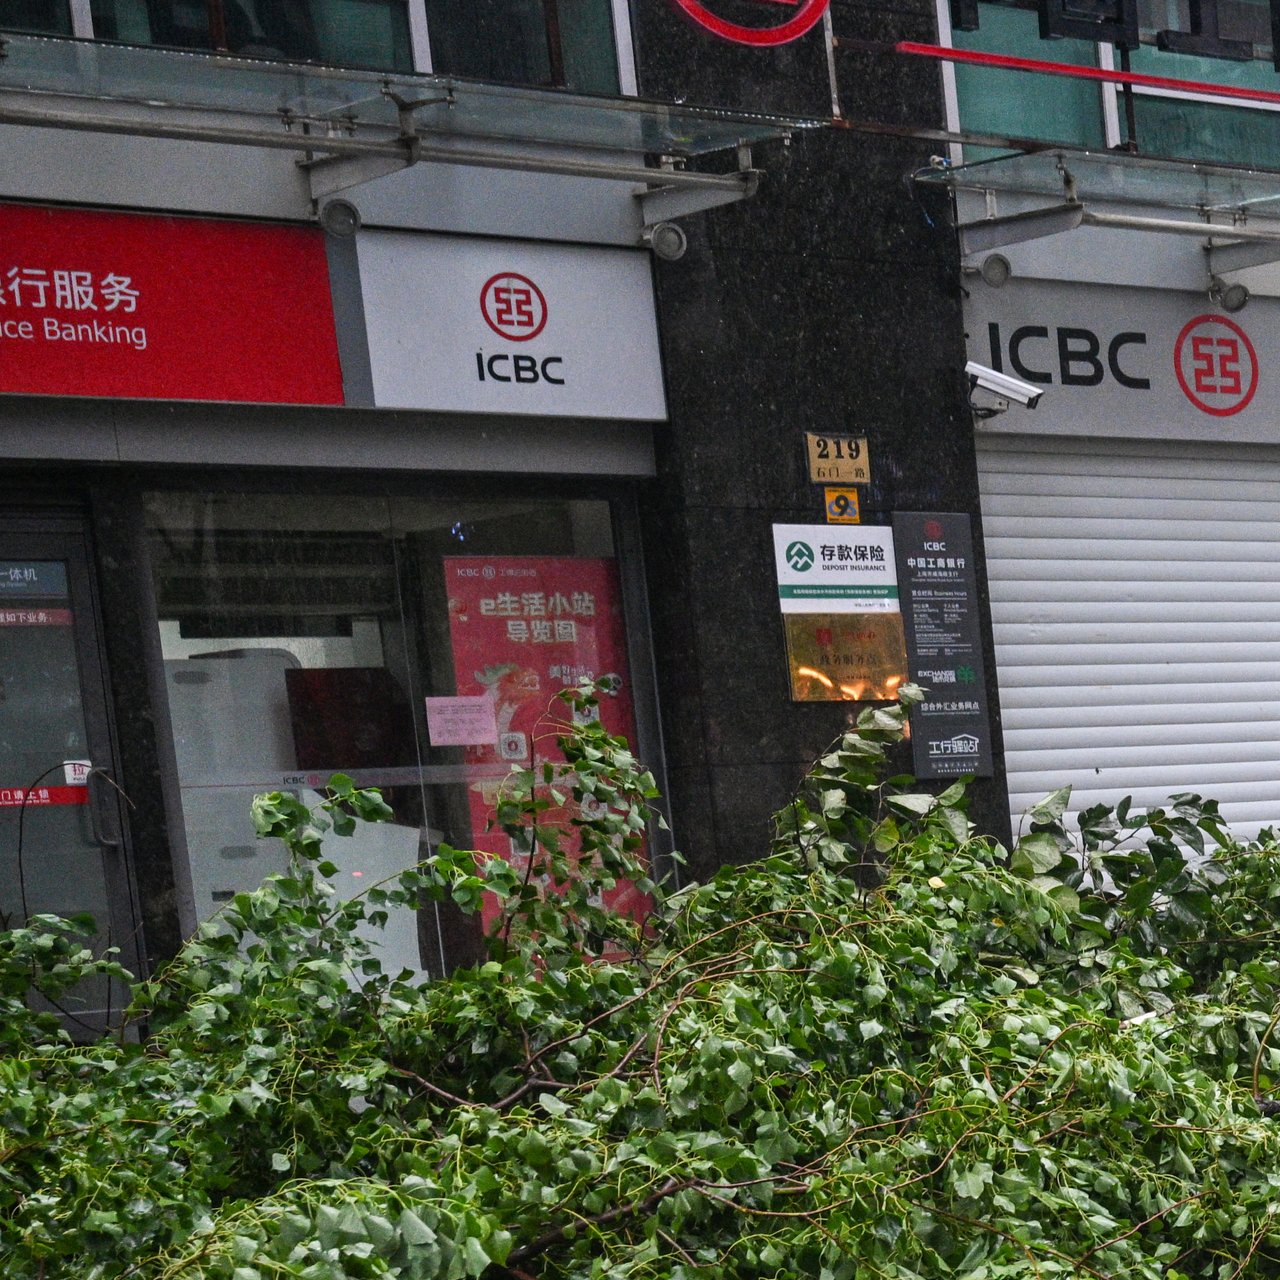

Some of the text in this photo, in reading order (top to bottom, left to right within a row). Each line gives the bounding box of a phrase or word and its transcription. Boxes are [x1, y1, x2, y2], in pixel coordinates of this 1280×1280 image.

[0, 266, 140, 313] 行服务
[0, 317, 147, 350] ce Banking
[988, 322, 1150, 389] ICBC
[476, 352, 565, 385] ICBC
[816, 439, 861, 459] 219
[820, 544, 886, 562] 存款保险
[923, 542, 946, 551] ICBC
[907, 557, 966, 569] 中国工商银行
[480, 591, 596, 617] e生活小站
[506, 620, 578, 643] 导览图
[283, 776, 305, 785] ICBC
